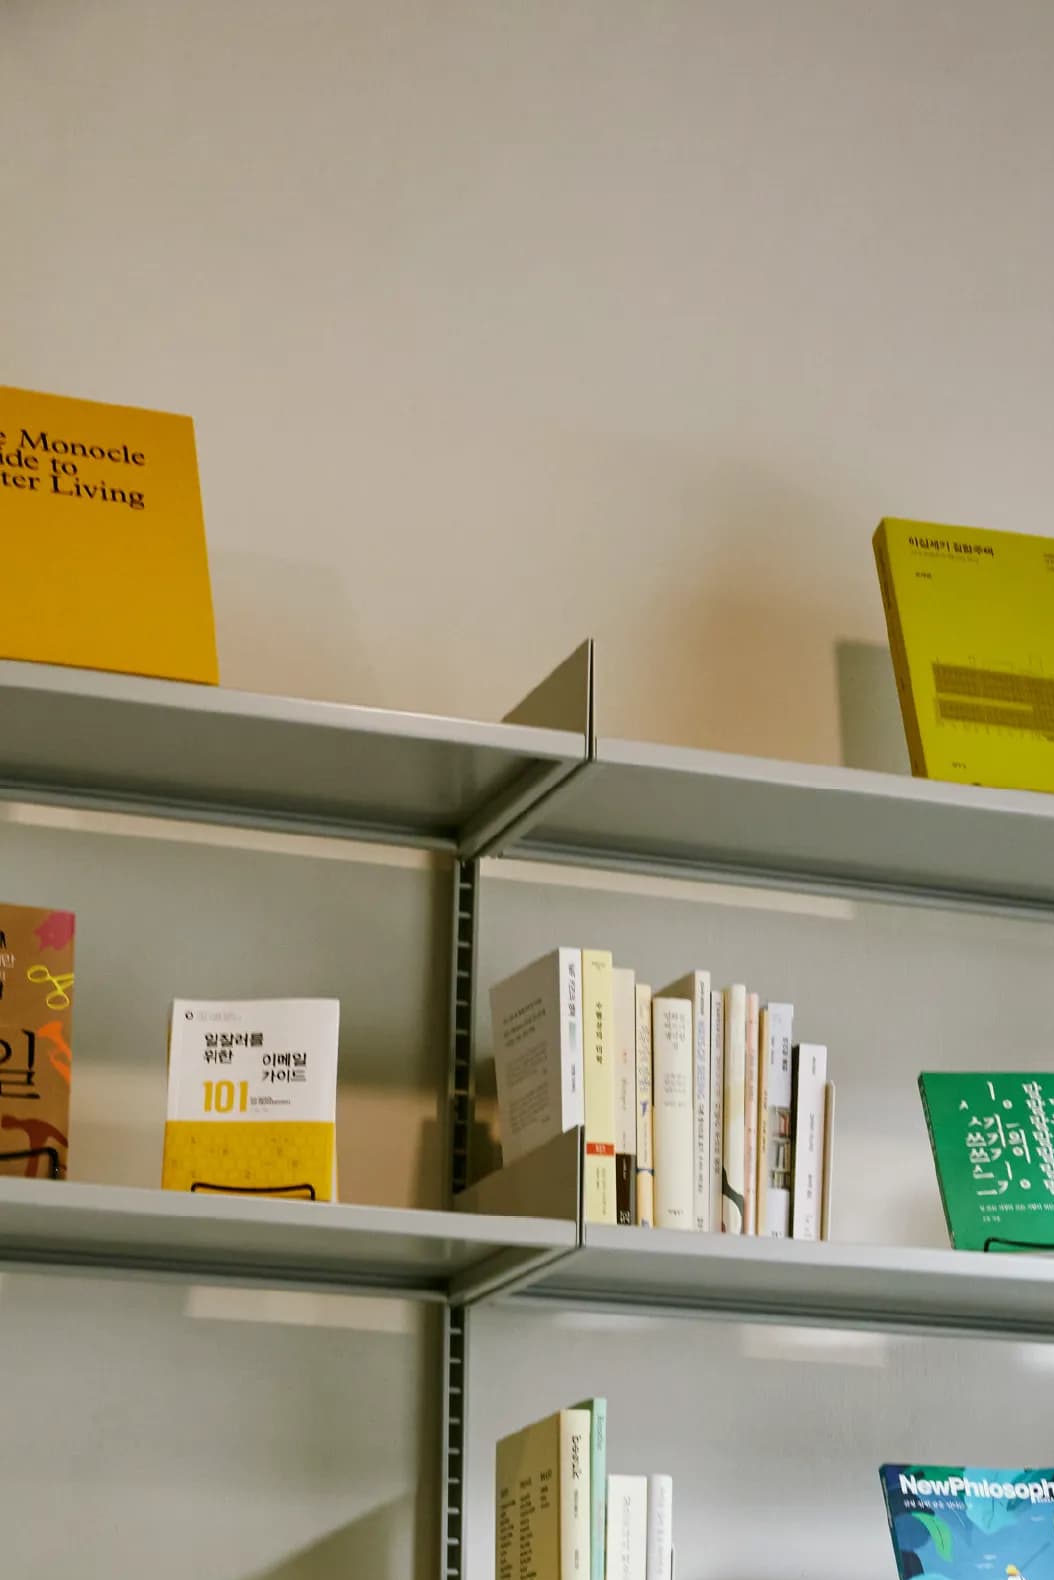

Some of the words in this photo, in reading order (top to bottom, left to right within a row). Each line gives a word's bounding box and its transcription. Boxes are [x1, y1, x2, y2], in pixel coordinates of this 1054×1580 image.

[20, 429, 145, 466] Monocle
[51, 458, 78, 476] to
[51, 474, 145, 510] Living
[204, 1032, 264, 1048] 일잘러를
[203, 1050, 233, 1065] 위한
[262, 1053, 307, 1067] 이메일
[262, 1070, 307, 1083] 가이드
[203, 1079, 249, 1113] 101
